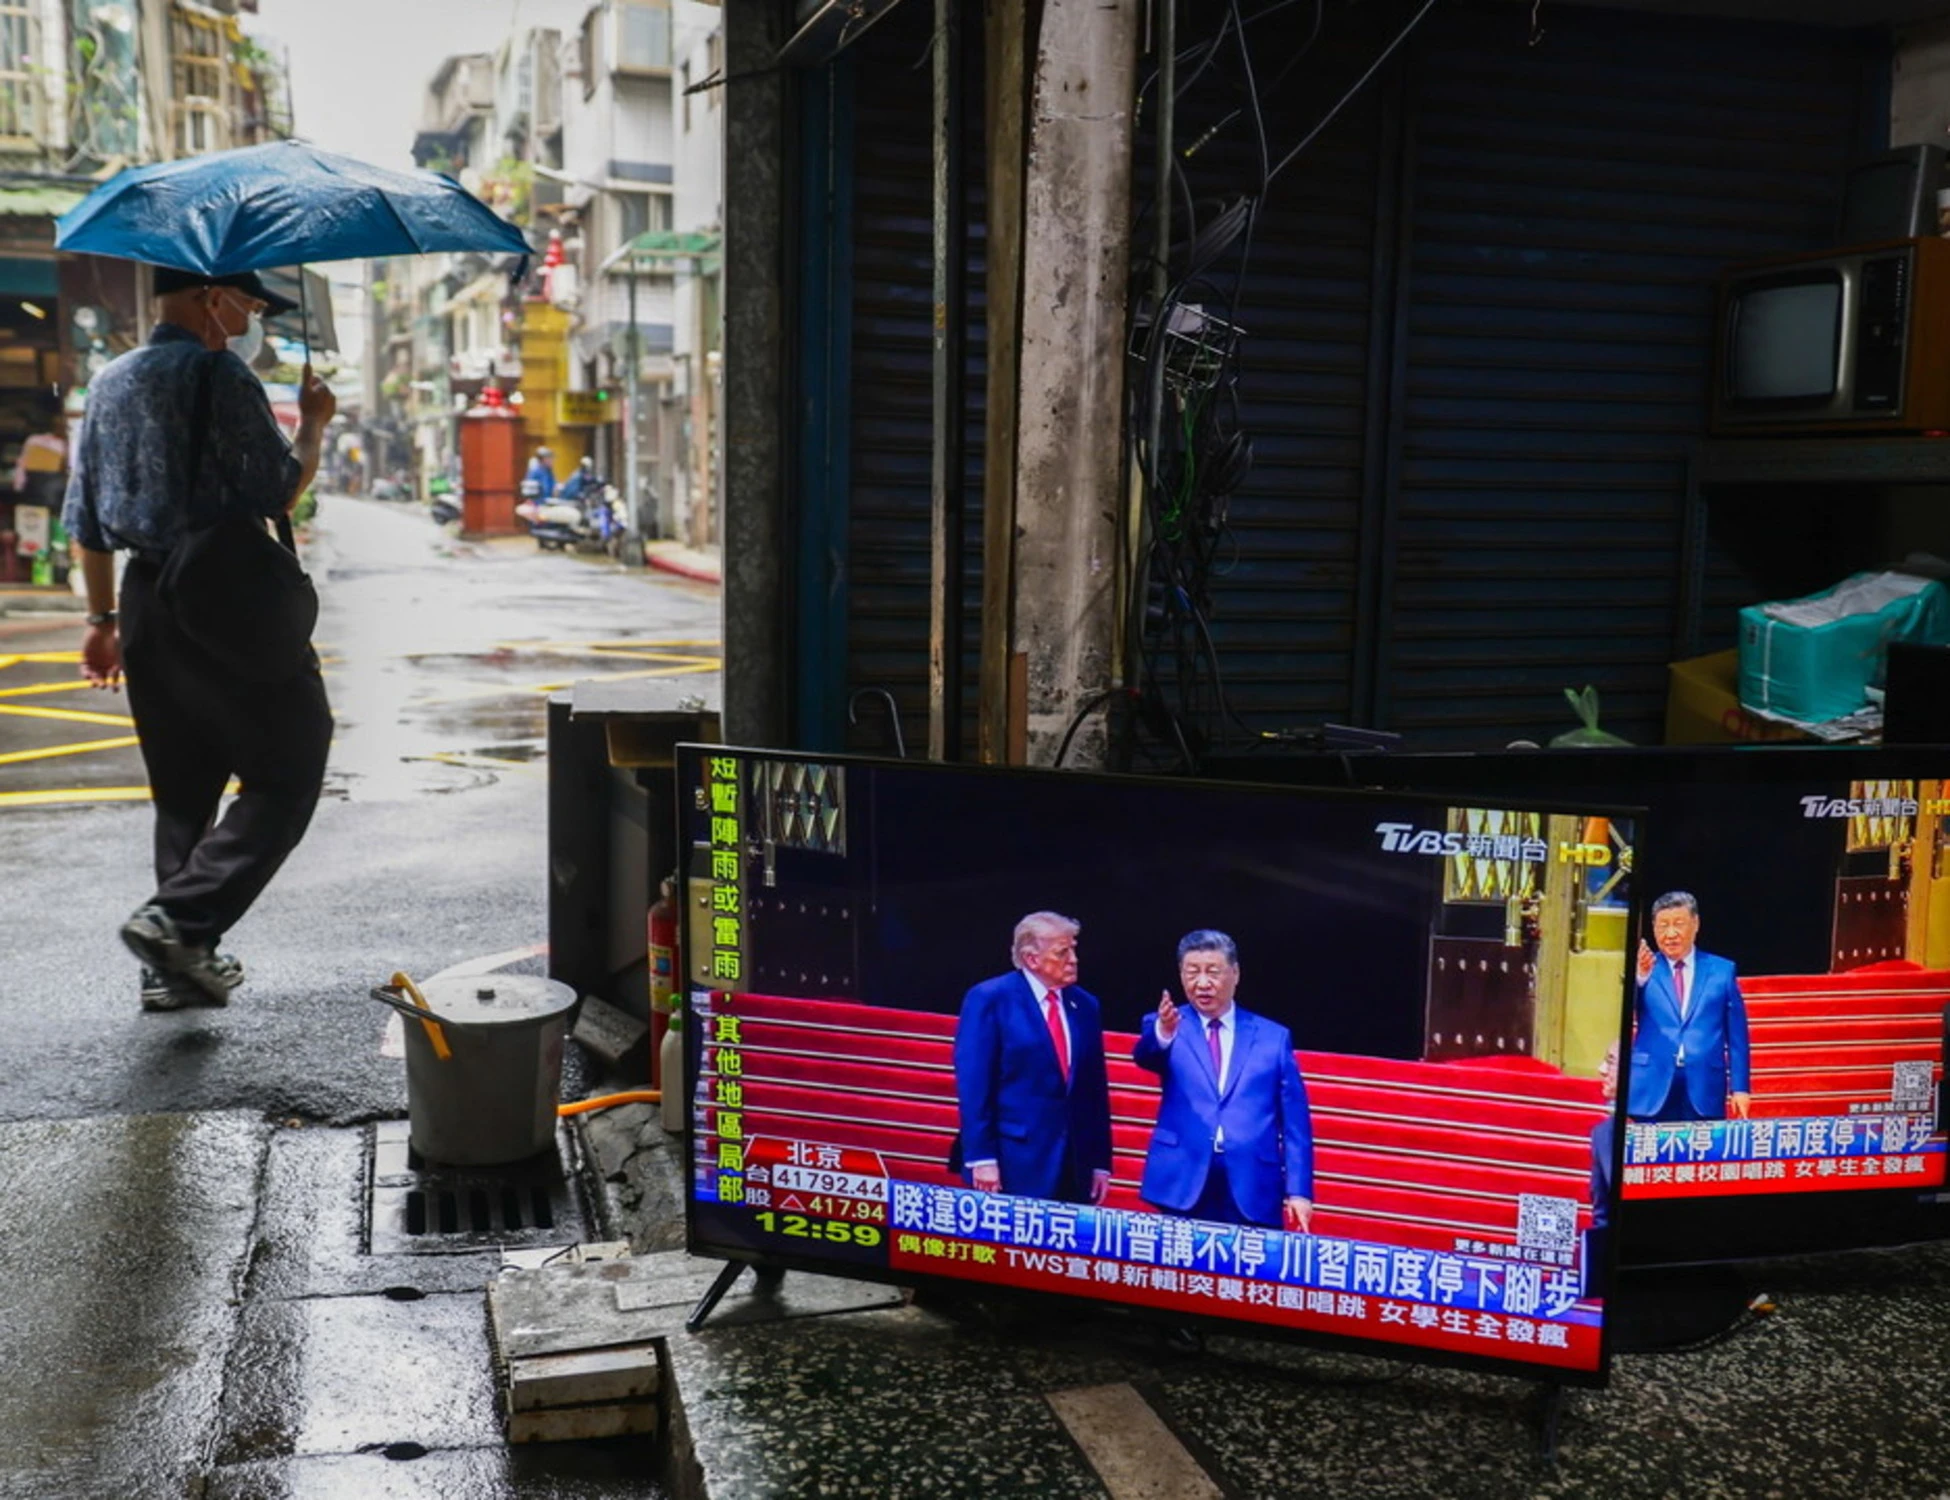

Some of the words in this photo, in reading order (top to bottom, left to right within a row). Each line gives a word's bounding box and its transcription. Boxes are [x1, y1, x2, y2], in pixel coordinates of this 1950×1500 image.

[1559, 841, 1611, 866] HD
[1723, 1115, 1932, 1159] 川習兩度停下腳步
[787, 1141, 842, 1169] 北京
[777, 1168, 884, 1198] 41792.44
[810, 1196, 885, 1221] 417.94
[755, 1211, 881, 1247] 12:59
[893, 1184, 1078, 1250] 睽違9年訪京
[1091, 1208, 1267, 1277] 川普講不停
[1279, 1232, 1579, 1318] 川習兩度停下腳步
[898, 1234, 996, 1265] 偶像打歌
[1379, 1302, 1569, 1349] 女學生全發瘋
